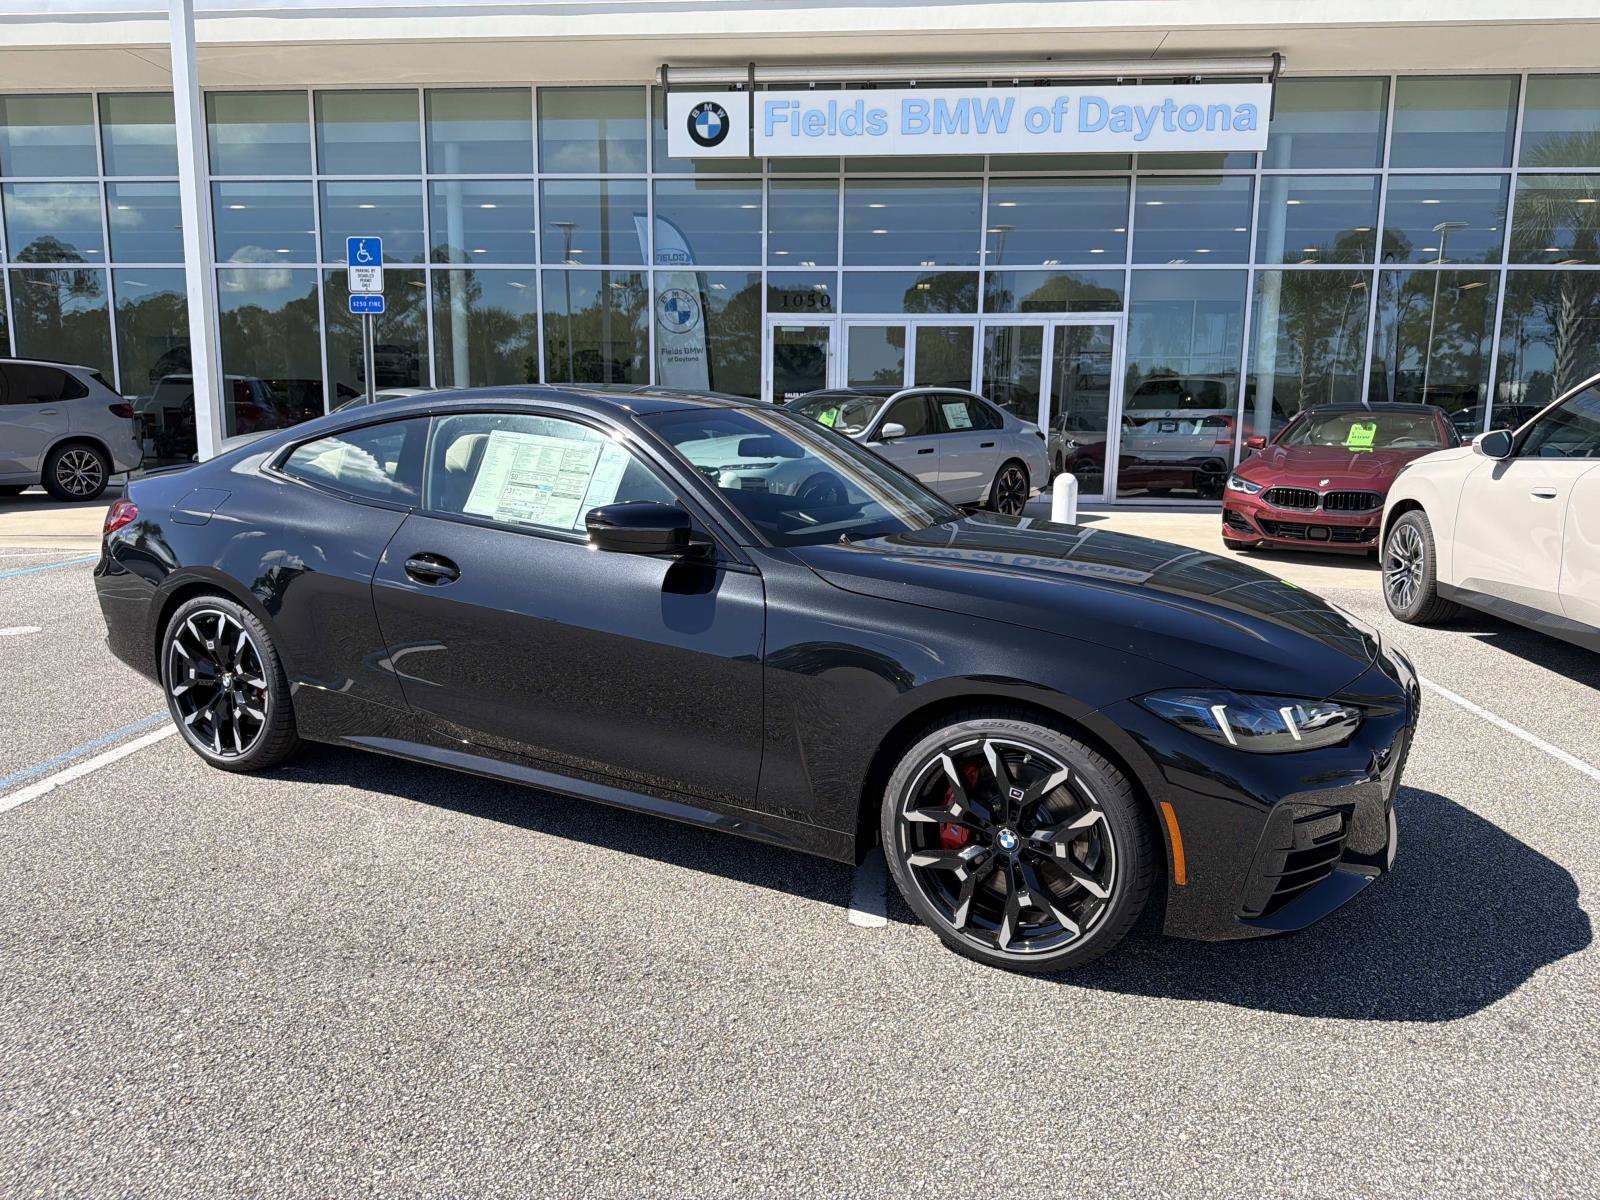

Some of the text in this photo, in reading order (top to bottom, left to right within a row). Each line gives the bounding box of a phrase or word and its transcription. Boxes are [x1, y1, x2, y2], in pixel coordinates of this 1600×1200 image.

[691, 103, 726, 119] BMW
[764, 94, 1258, 142] Fields BMW of Daytona
[782, 294, 831, 308] 1050
[661, 347, 683, 355] Fields
